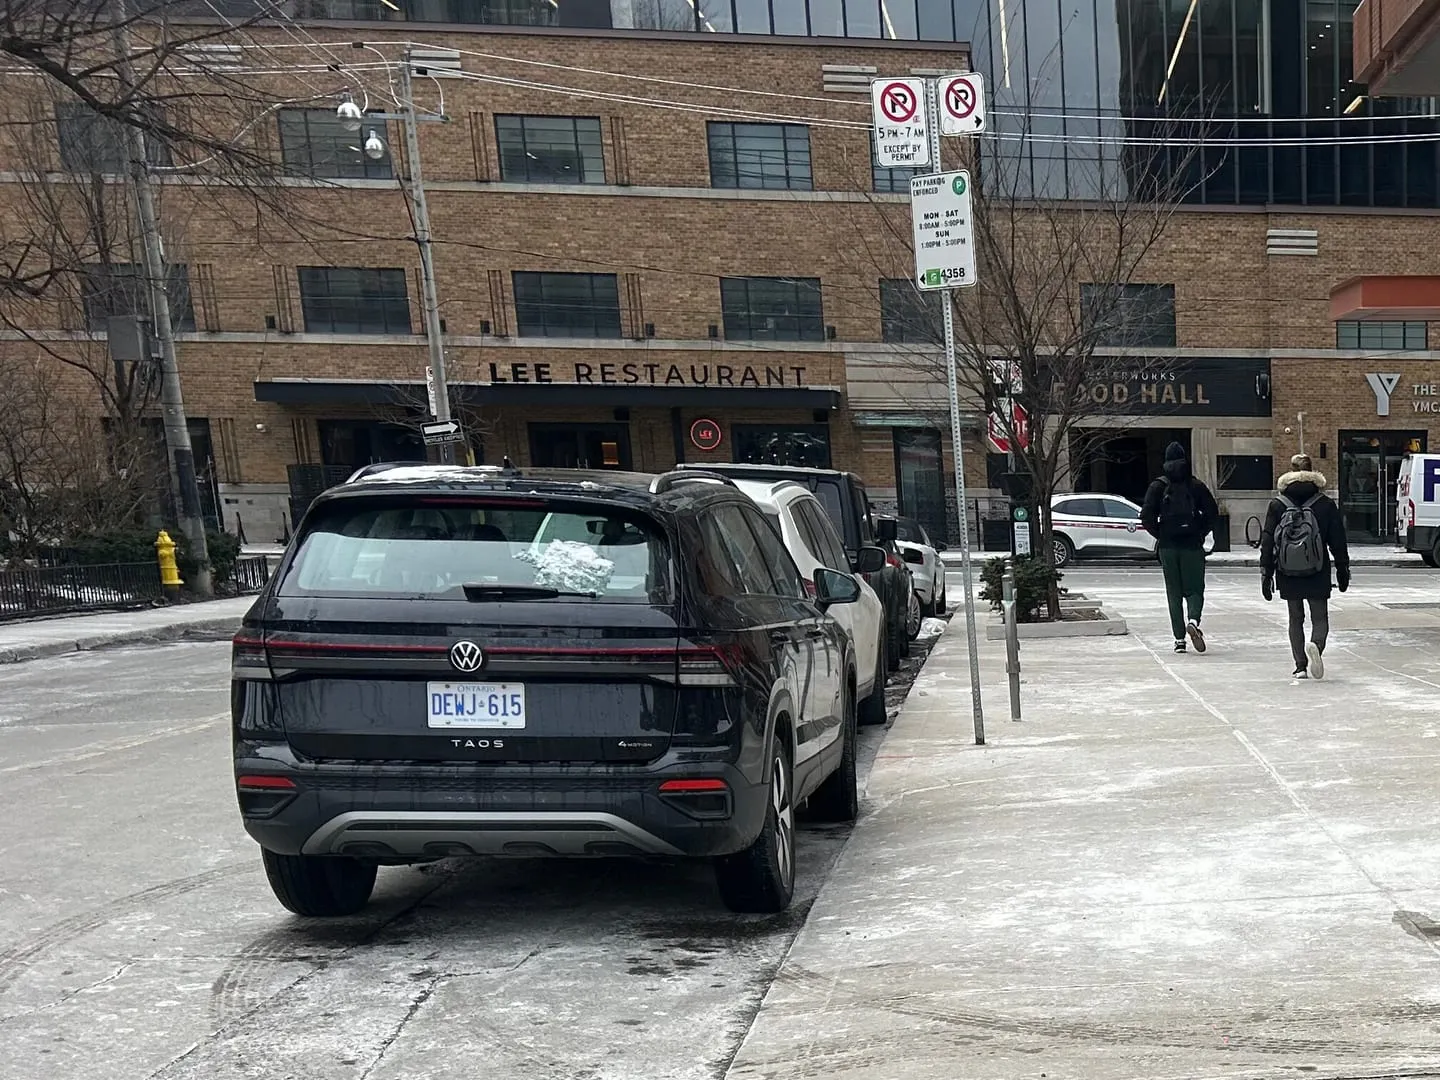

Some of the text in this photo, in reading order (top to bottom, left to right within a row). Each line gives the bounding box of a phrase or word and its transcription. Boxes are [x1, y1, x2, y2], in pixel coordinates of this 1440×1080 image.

[879, 127, 885, 138] 5
[887, 129, 898, 137] PM
[906, 127, 911, 137] 7
[913, 129, 924, 137] AM
[883, 144, 921, 154] EXCEPT BY
[891, 152, 915, 161] PERMIT
[912, 180, 922, 188] PAY
[912, 187, 938, 196] ENFORCED
[923, 212, 939, 220] MON
[945, 209, 959, 217] SAT
[935, 230, 950, 238] SUN
[940, 267, 966, 279] 4358
[489, 362, 807, 386] LEE RESTAURANT
[1140, 383, 1210, 404] HALL
[1412, 384, 1437, 396] THE
[457, 685, 496, 693] ONTARIO
[431, 693, 522, 717] DEWJ 615
[451, 739, 504, 748] TAOS
